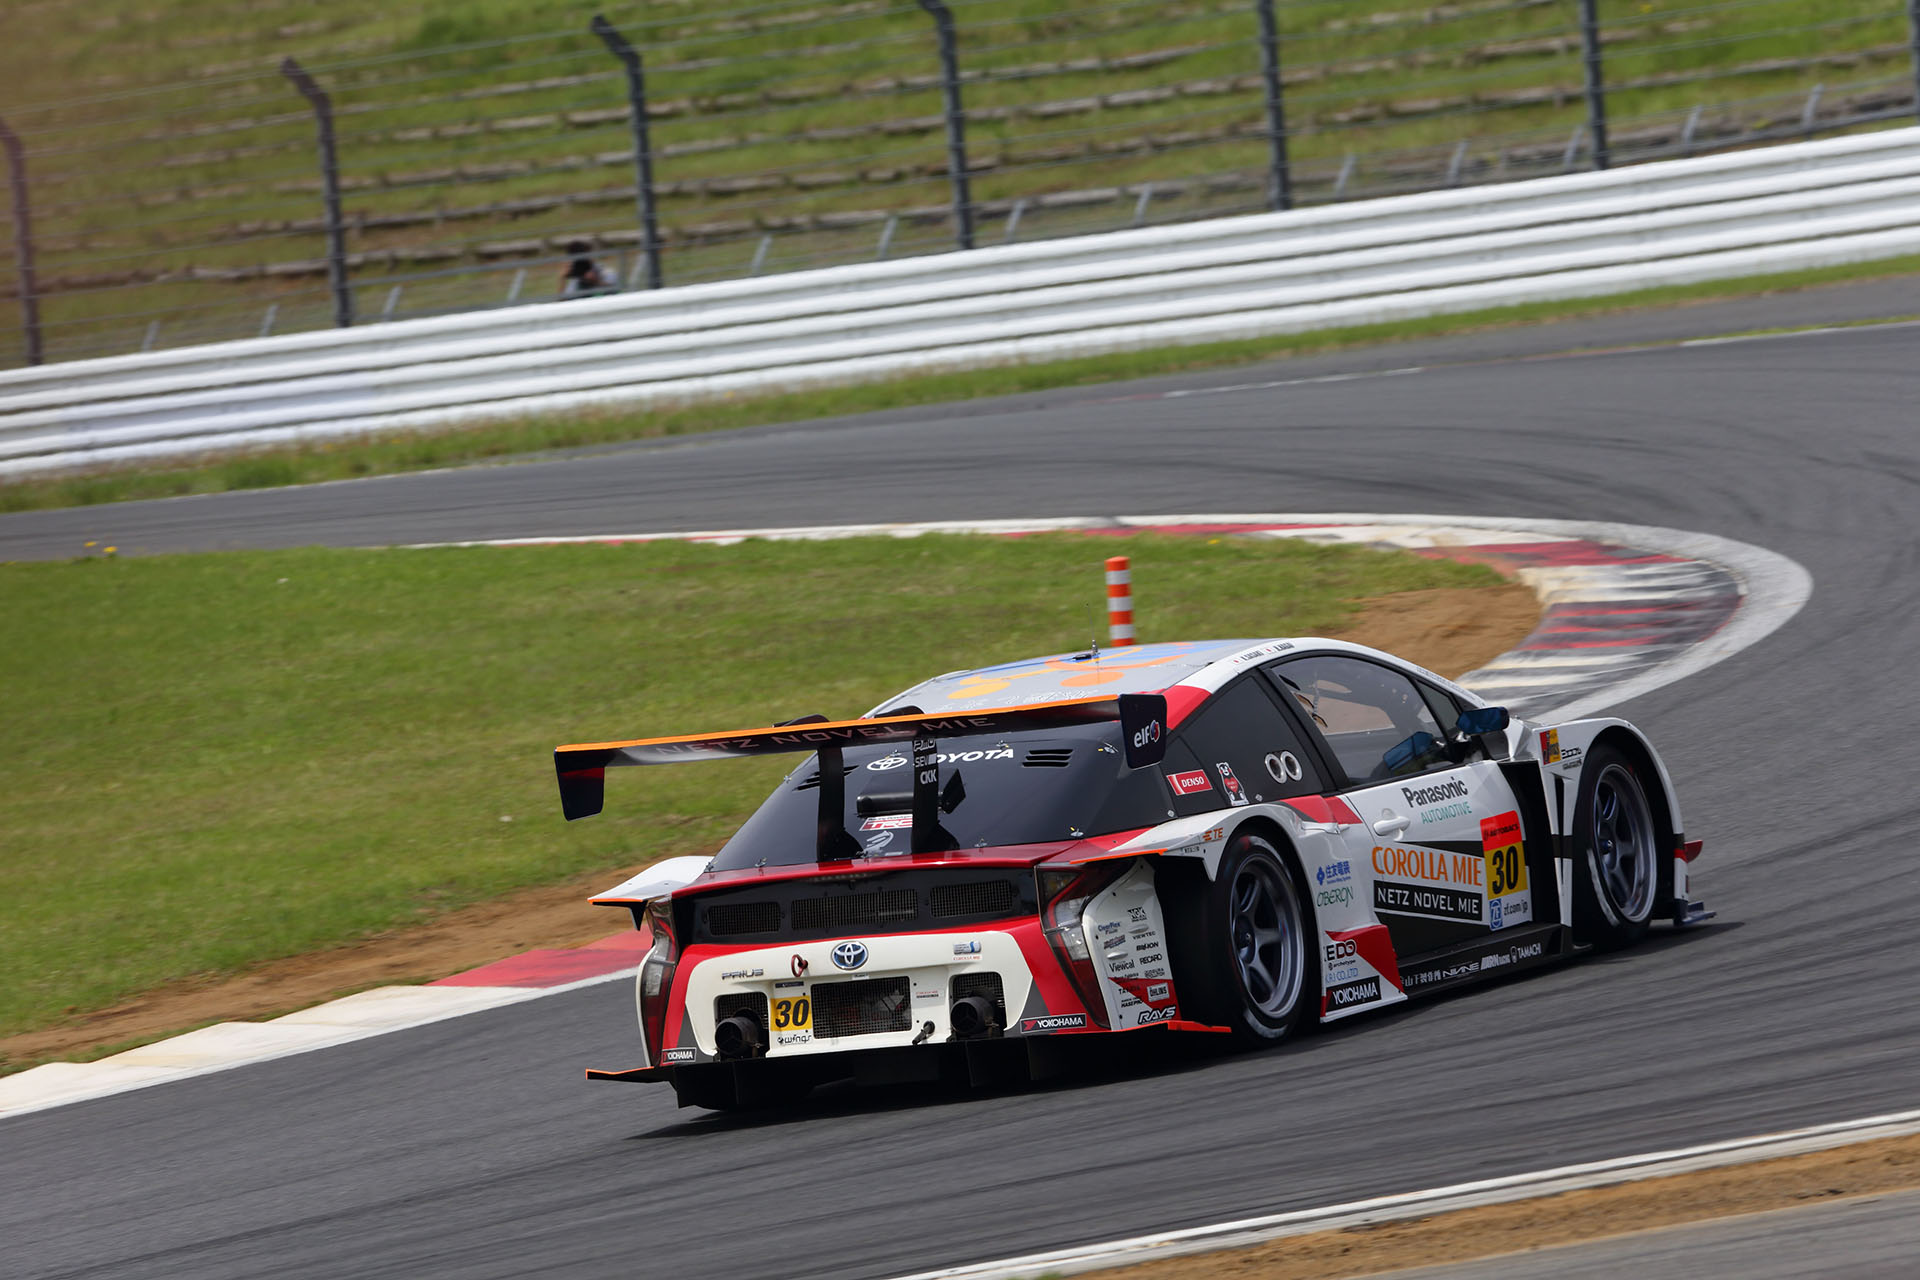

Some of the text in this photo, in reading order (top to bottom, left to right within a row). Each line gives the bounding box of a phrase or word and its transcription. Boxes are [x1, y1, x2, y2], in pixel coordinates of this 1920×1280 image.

[656, 718, 995, 755] NETZ NOVEL MIE
[1134, 725, 1150, 748] elf
[920, 769, 937, 785] CKK
[1181, 776, 1205, 788] DENSO
[1402, 777, 1468, 808] Panasonic
[1420, 802, 1473, 824] AUTOMOTIVE
[1372, 846, 1482, 886] COROLLA MIE
[1491, 845, 1519, 895] 30
[1317, 886, 1354, 908] OBERON
[1377, 887, 1479, 914] NETZ NOVEL MIE
[1132, 931, 1156, 940] VIEWTEC
[1139, 954, 1163, 965] RECARO
[1517, 943, 1541, 959] TAMACHI
[1109, 959, 1135, 972] Viewcal
[1333, 959, 1357, 968] archetype
[722, 968, 764, 981] PRIUS
[1332, 983, 1378, 1005] YOKOHAMA
[774, 998, 809, 1028] 30
[1037, 1017, 1083, 1028] YOKOHAMA
[1138, 1006, 1176, 1024] RAYS
